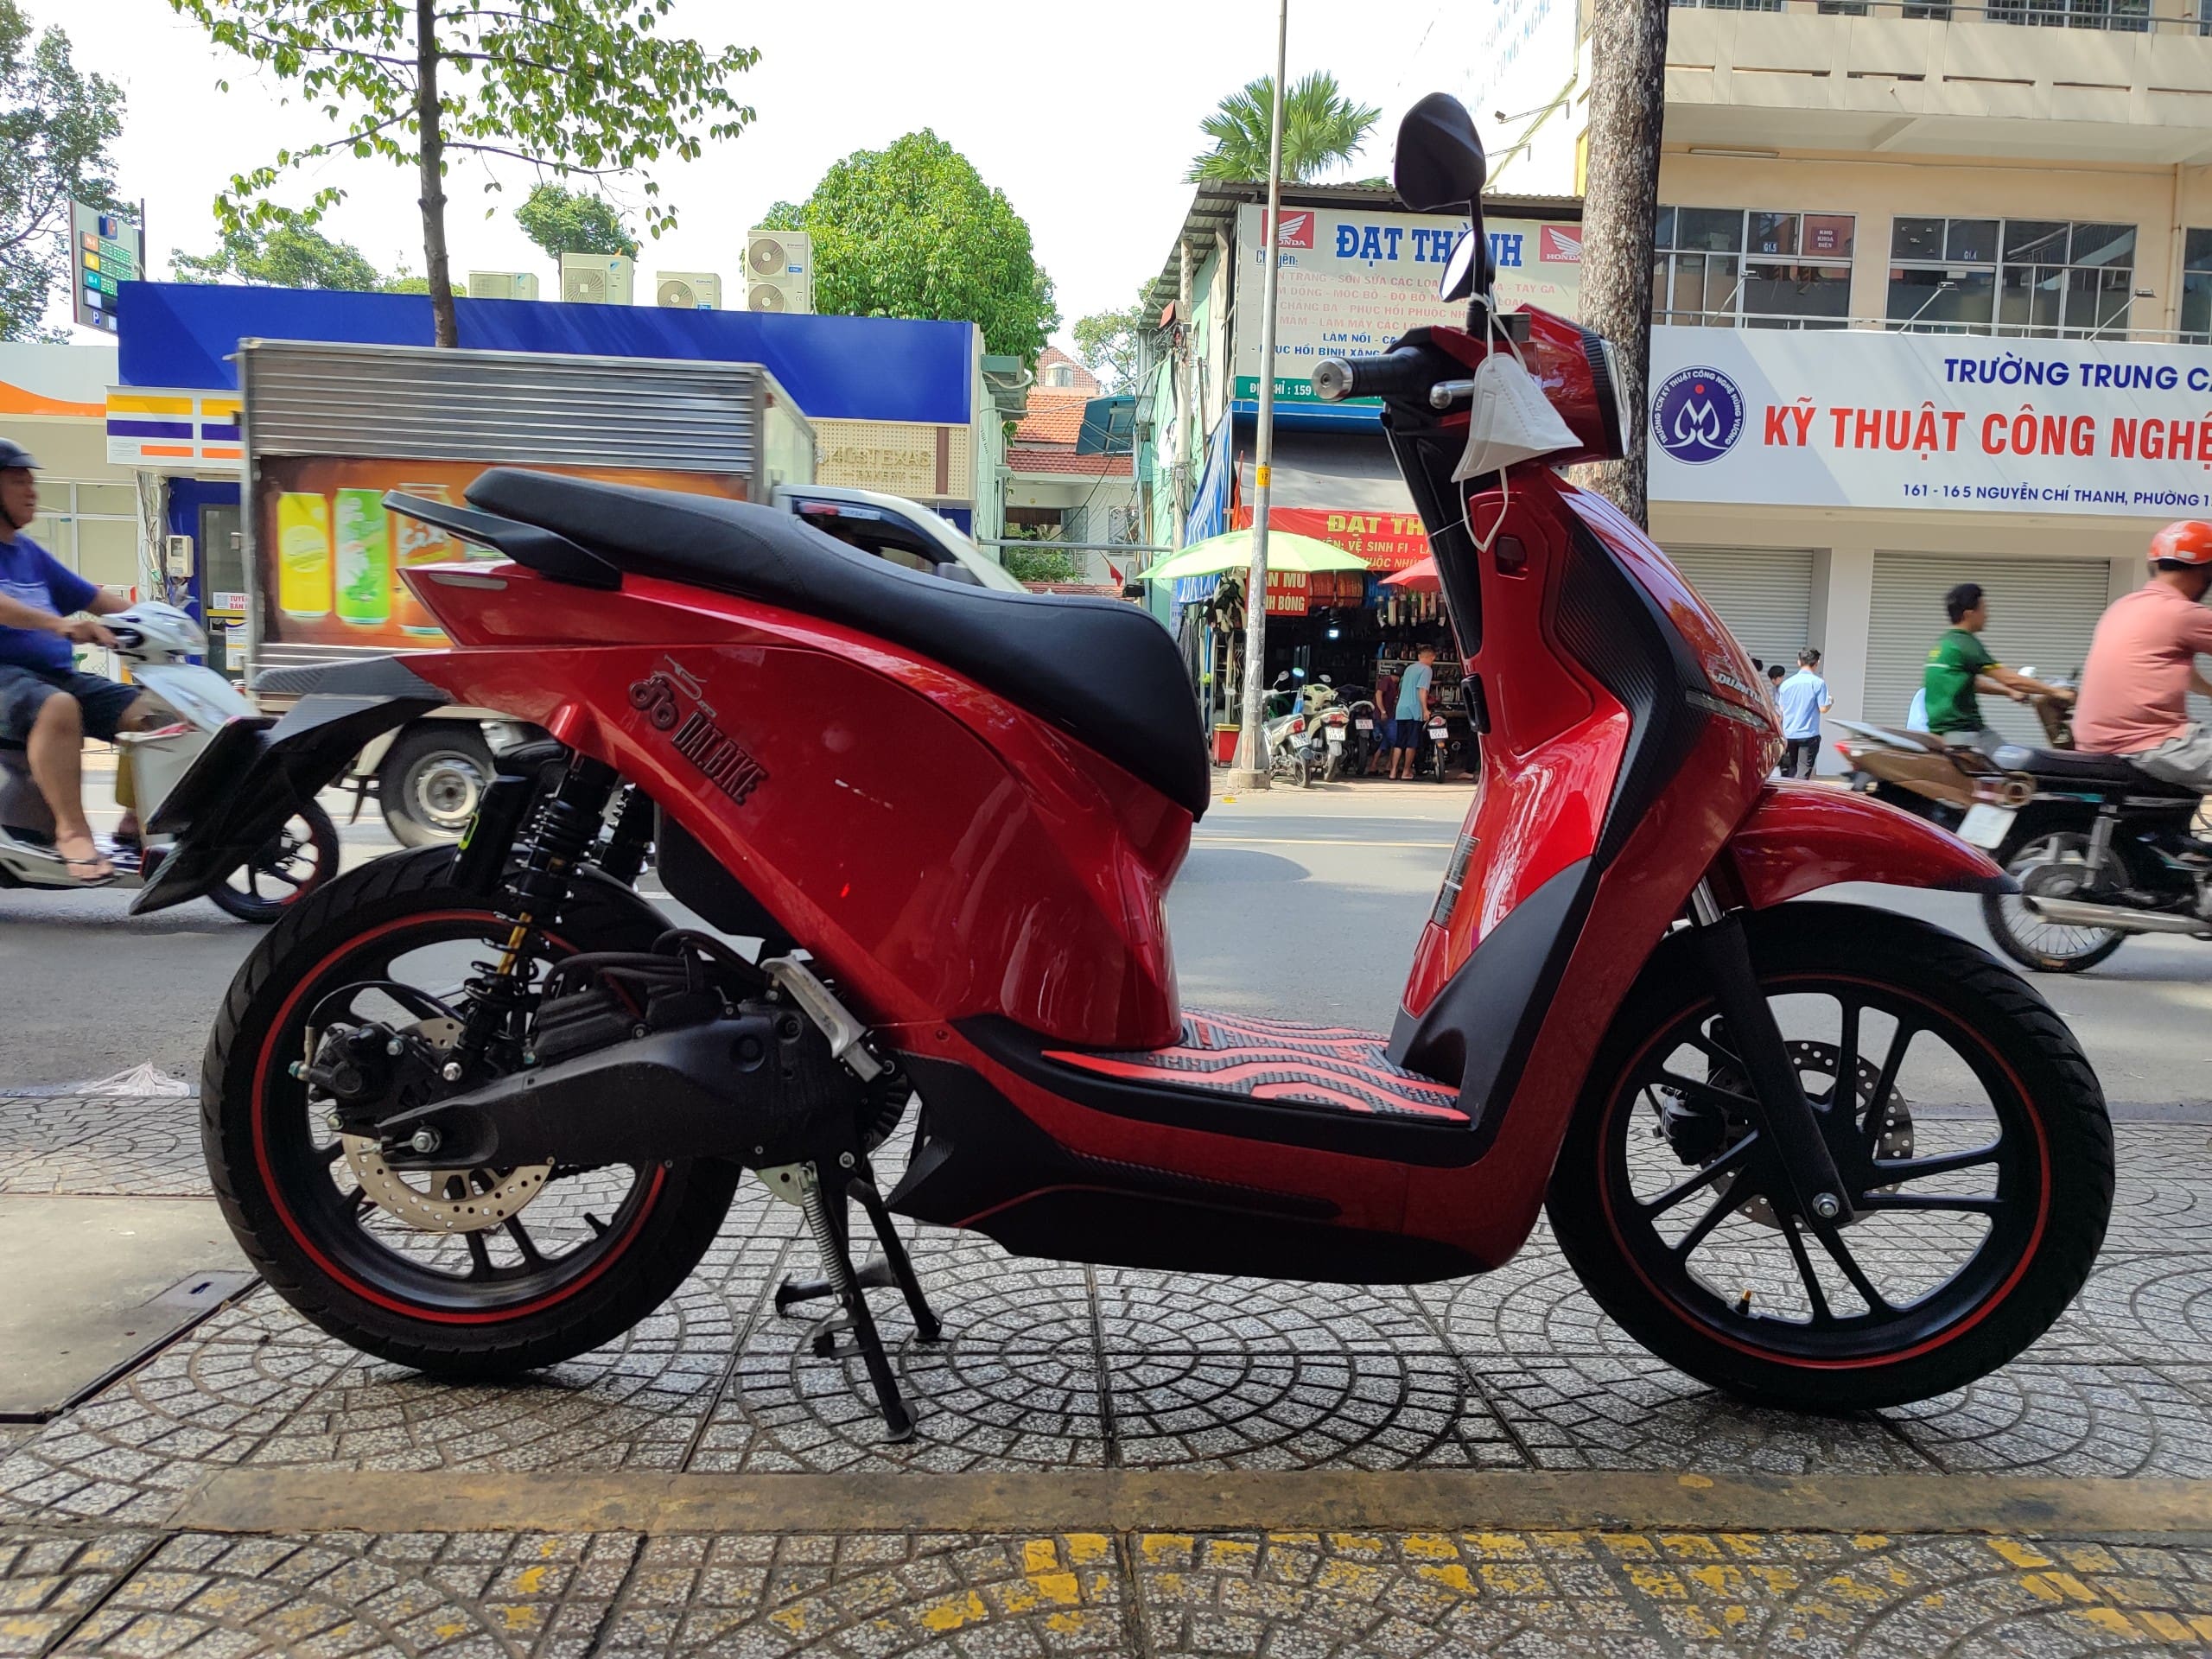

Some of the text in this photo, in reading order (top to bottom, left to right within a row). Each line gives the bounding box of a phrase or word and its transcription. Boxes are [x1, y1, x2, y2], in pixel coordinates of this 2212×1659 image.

[1336, 224, 1403, 267] ĐẠT
[1323, 331, 1348, 343] LÀM
[1944, 351, 2069, 386] TRƯỜNG
[2079, 363, 2178, 390] TRUNG
[1294, 385, 1312, 396] 159
[1764, 396, 1817, 447] KỸ
[1829, 400, 1967, 461] THUẬT
[1981, 403, 2095, 457] CÔNG
[1903, 484, 1928, 497] 161
[1976, 481, 2039, 500] NGUYỄN
[2042, 484, 2072, 502] CHÍ
[2074, 489, 2128, 506] THANH,
[2133, 489, 2200, 507] PHƯỜNG
[1327, 514, 1382, 537] ĐẠT
[1367, 542, 1394, 553] SINH
[1278, 592, 1306, 612] BÓNG
